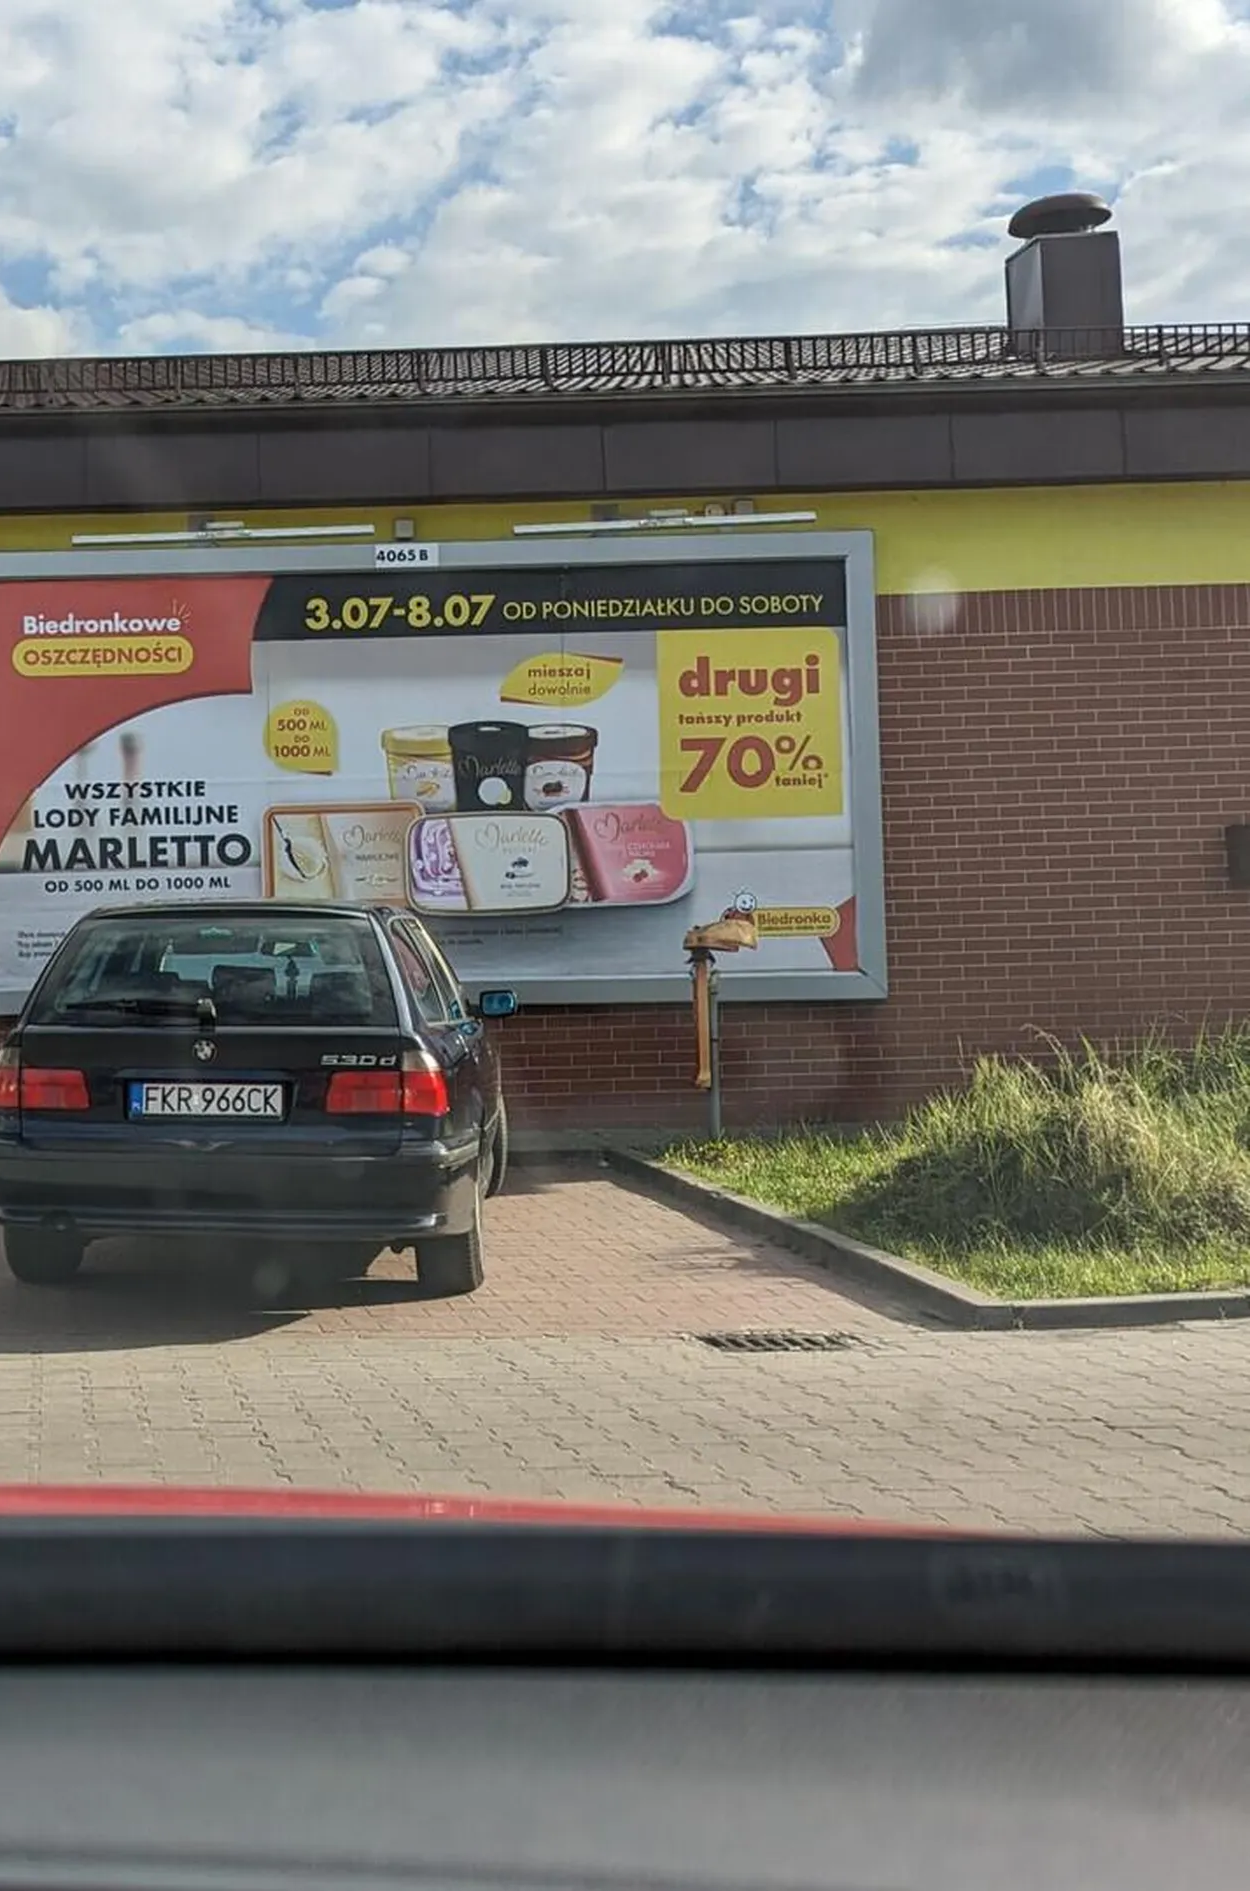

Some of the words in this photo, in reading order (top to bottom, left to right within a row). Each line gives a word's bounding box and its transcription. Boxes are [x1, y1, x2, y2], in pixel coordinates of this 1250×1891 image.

[375, 550, 416, 562] 4065
[419, 550, 429, 561] B
[305, 594, 496, 630] 3.07-8.07
[502, 601, 537, 620] OD
[542, 597, 695, 619] PONIEDZIAŁKU
[701, 596, 734, 615] DO
[739, 594, 824, 614] SOBOTY
[23, 612, 181, 635] Biedronkowe
[24, 641, 182, 668] OSZCZĘDNOŚCI
[528, 664, 591, 680] mieszaj
[679, 654, 820, 707] drugi
[528, 682, 591, 696] dowolnie
[294, 708, 310, 716] OD
[679, 712, 734, 727] tańszy
[737, 710, 803, 726] produkt
[277, 719, 307, 731] 500
[310, 720, 327, 731] ML
[274, 745, 310, 757] 1000
[313, 745, 331, 757] ML
[680, 735, 823, 793] 70%
[65, 781, 205, 800] WSZYSTKIE
[34, 808, 99, 828] LODY
[110, 805, 238, 827] FAMILIJNE
[21, 833, 252, 872] MARLETTO
[45, 880, 67, 892] OD
[74, 880, 103, 892] 500
[109, 879, 130, 891] ML
[136, 878, 159, 890] DO
[166, 877, 204, 889] 1000
[209, 876, 231, 888] ML
[758, 912, 831, 925] Biedronka
[145, 1086, 193, 1113] FKR
[202, 1086, 279, 1113] 966CK
